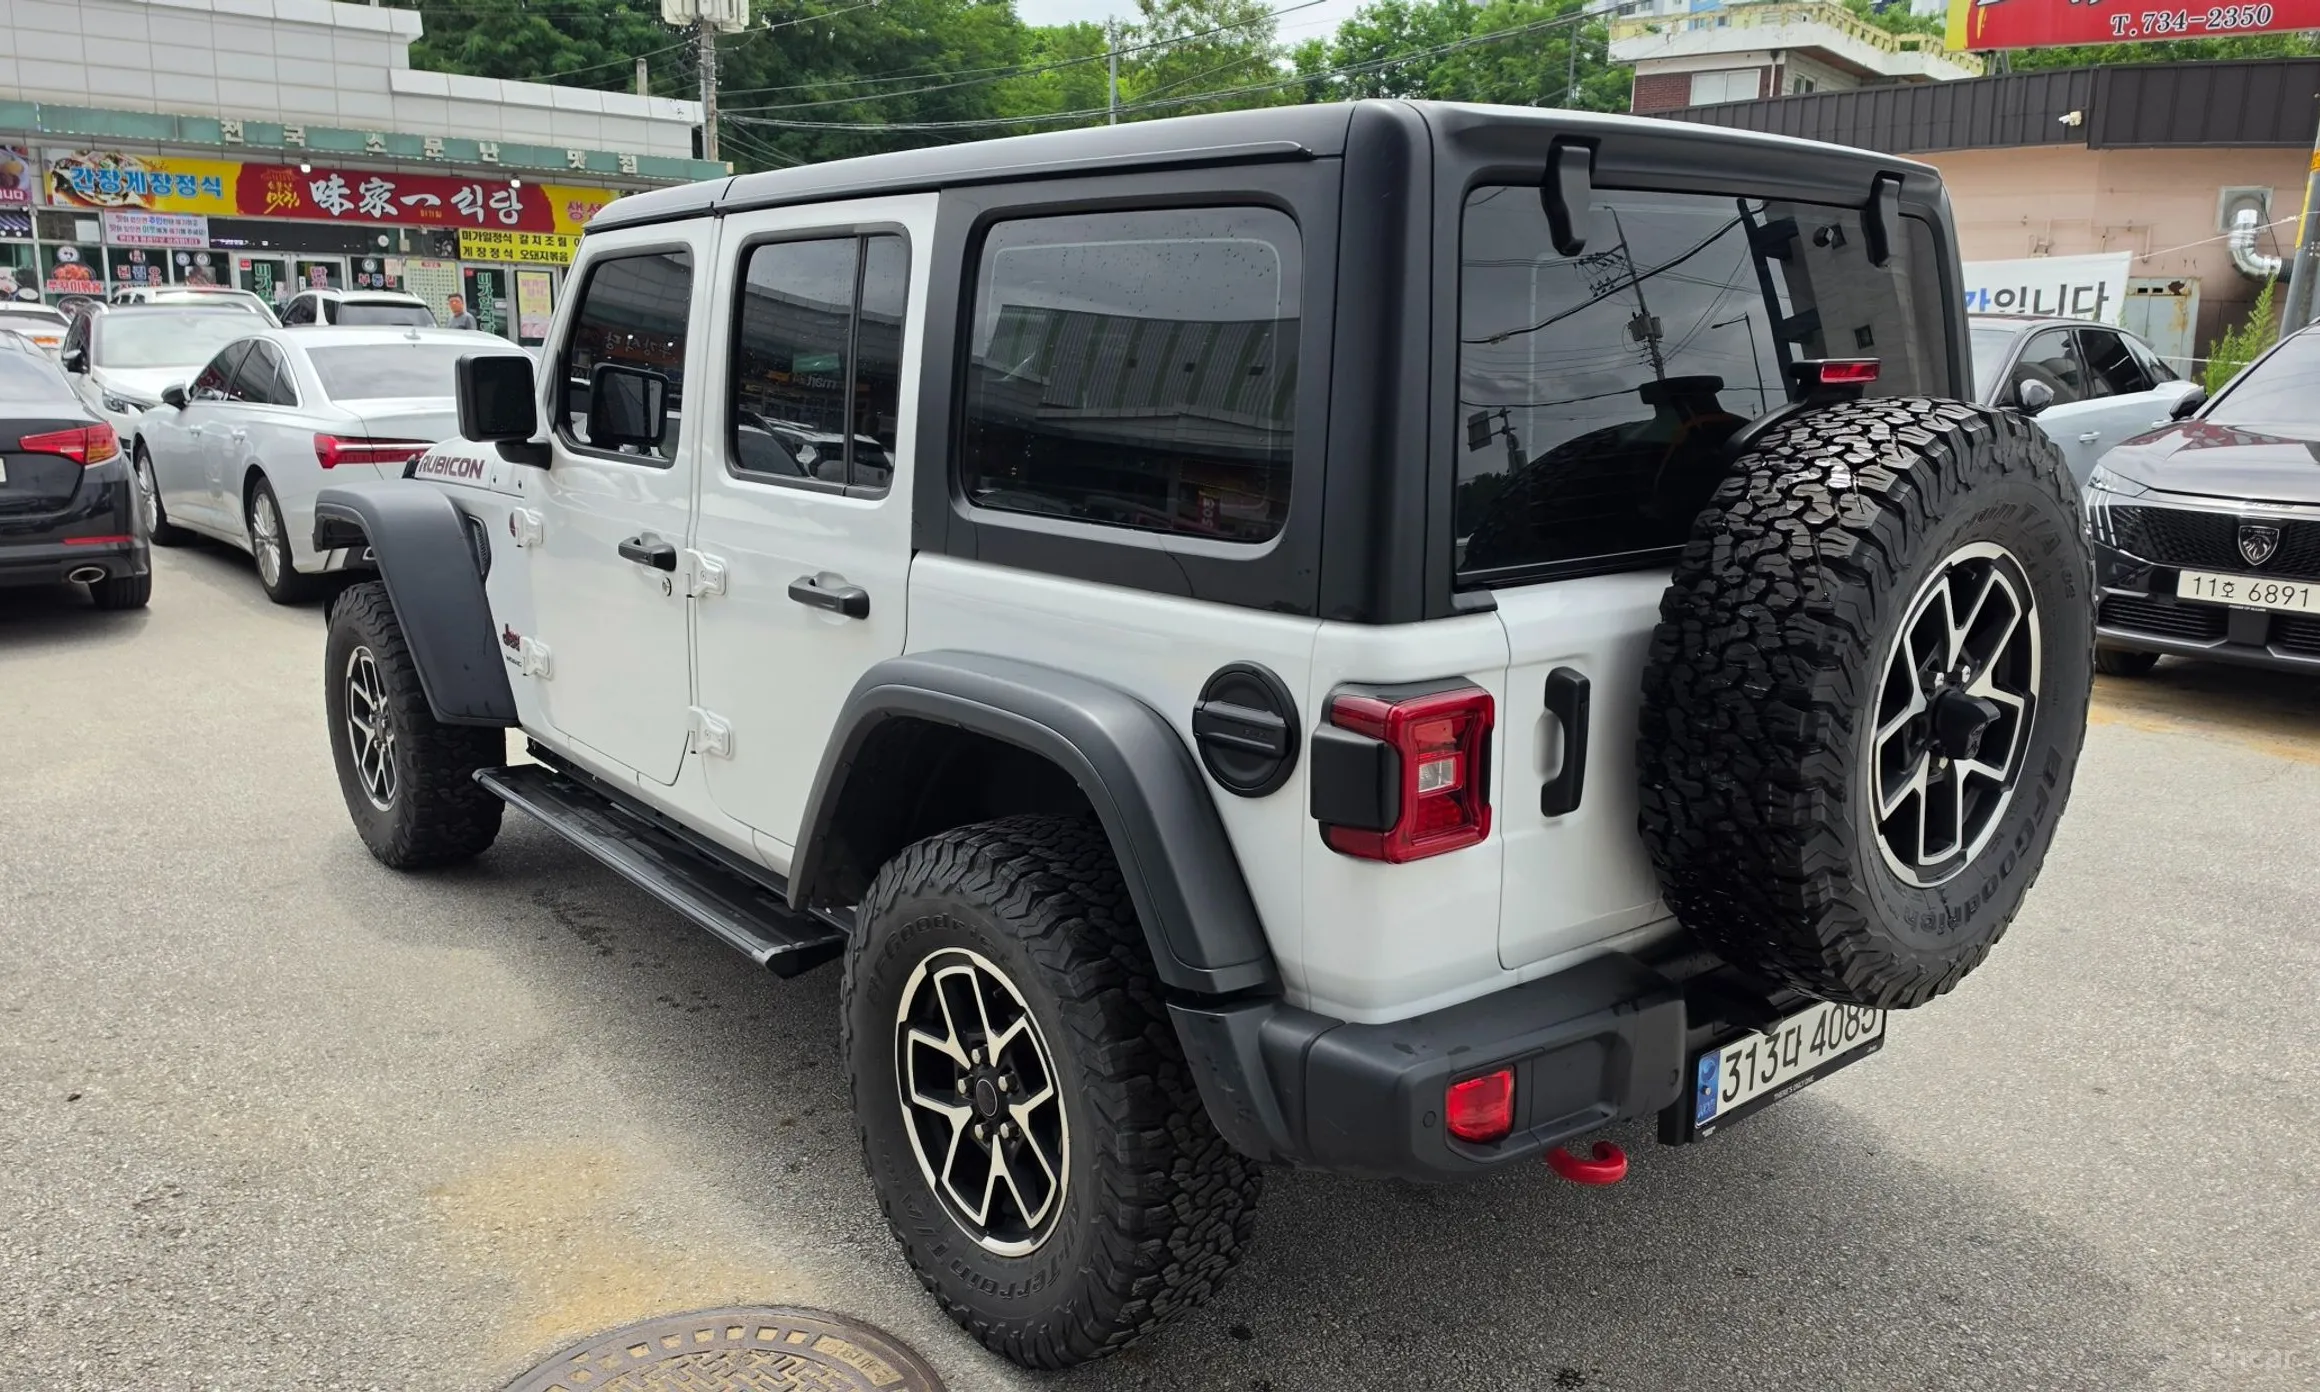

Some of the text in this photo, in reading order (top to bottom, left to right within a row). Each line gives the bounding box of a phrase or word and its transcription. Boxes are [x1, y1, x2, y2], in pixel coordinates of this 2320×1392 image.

[2110, 4, 2273, 36] T.734-2350
[365, 132, 500, 162] 소문난
[567, 149, 639, 174] 맛집
[70, 166, 223, 198] 간장게장정식
[451, 184, 524, 225] 식당
[461, 230, 513, 244] 미가일정식
[519, 234, 568, 248] 갈치조림
[462, 246, 514, 260] 게장정식
[418, 455, 485, 479] RUBICON
[2193, 576, 2310, 608] 11호 6891
[1722, 1001, 1878, 1104] 313다 4085
